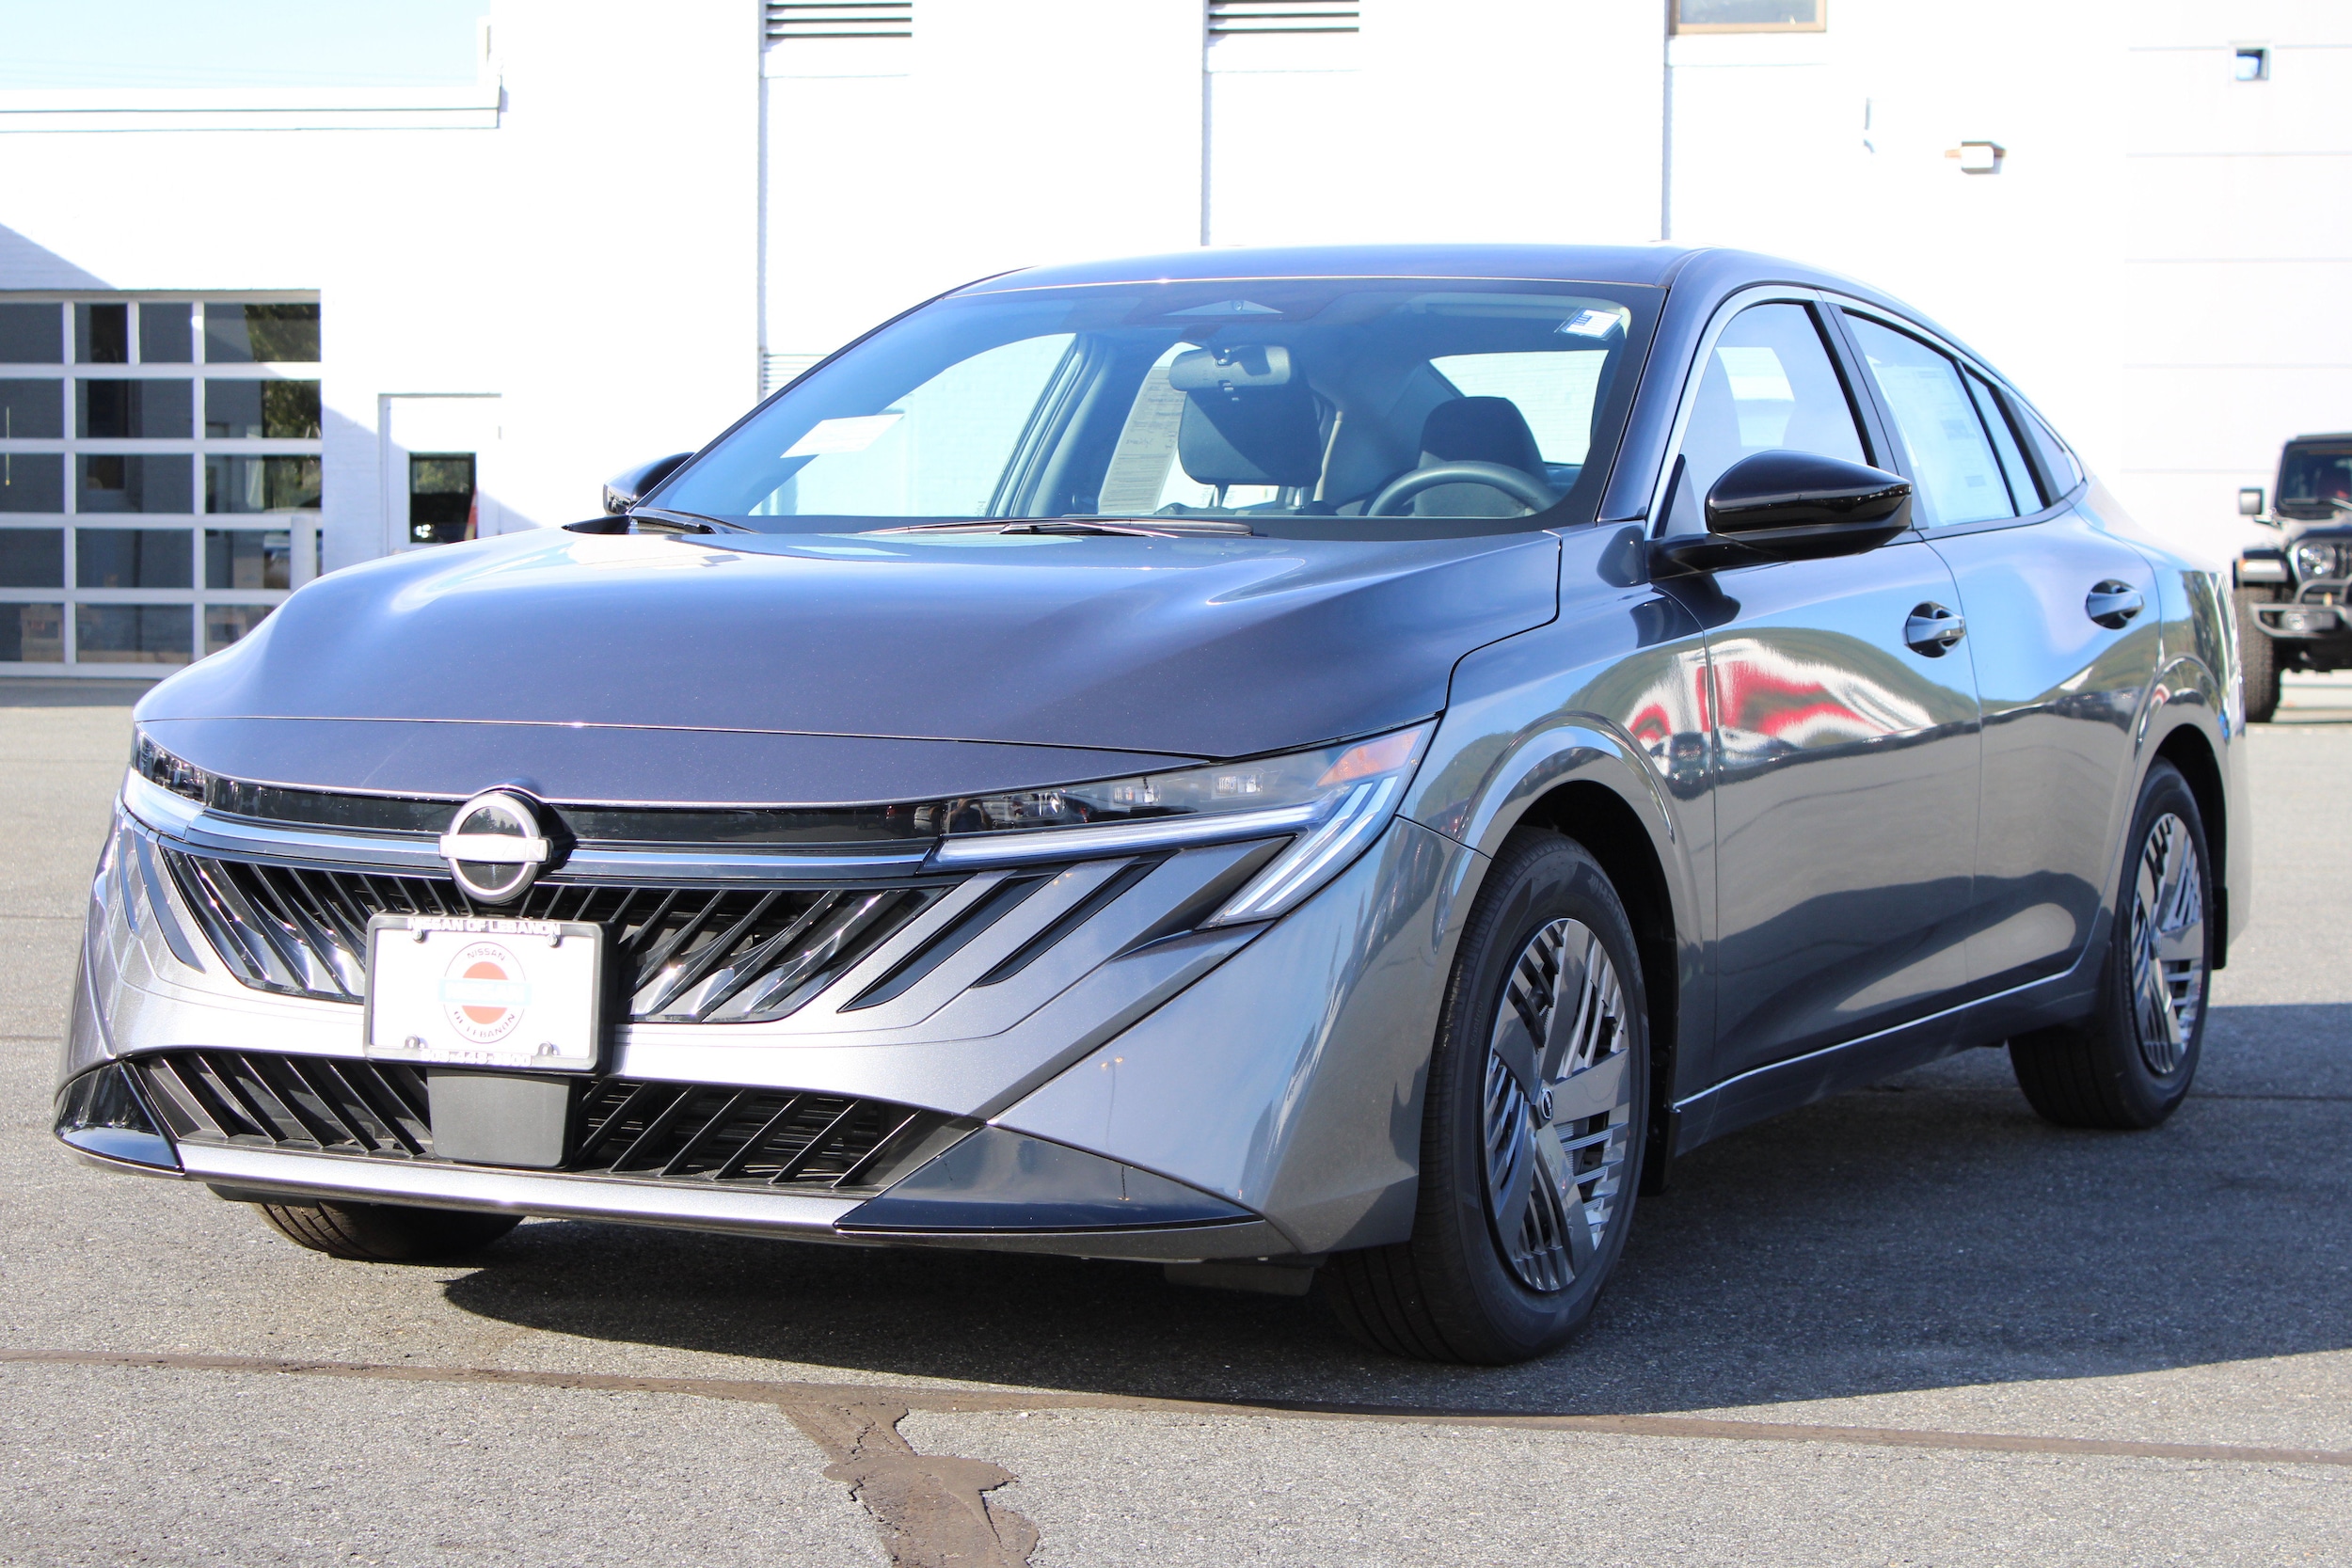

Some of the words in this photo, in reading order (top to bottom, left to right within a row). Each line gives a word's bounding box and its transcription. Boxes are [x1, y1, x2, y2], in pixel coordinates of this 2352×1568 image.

[407, 918, 463, 932] NISSAN
[466, 919, 488, 932] OF
[489, 921, 562, 935] LEBANON
[467, 948, 506, 961] NISSAN
